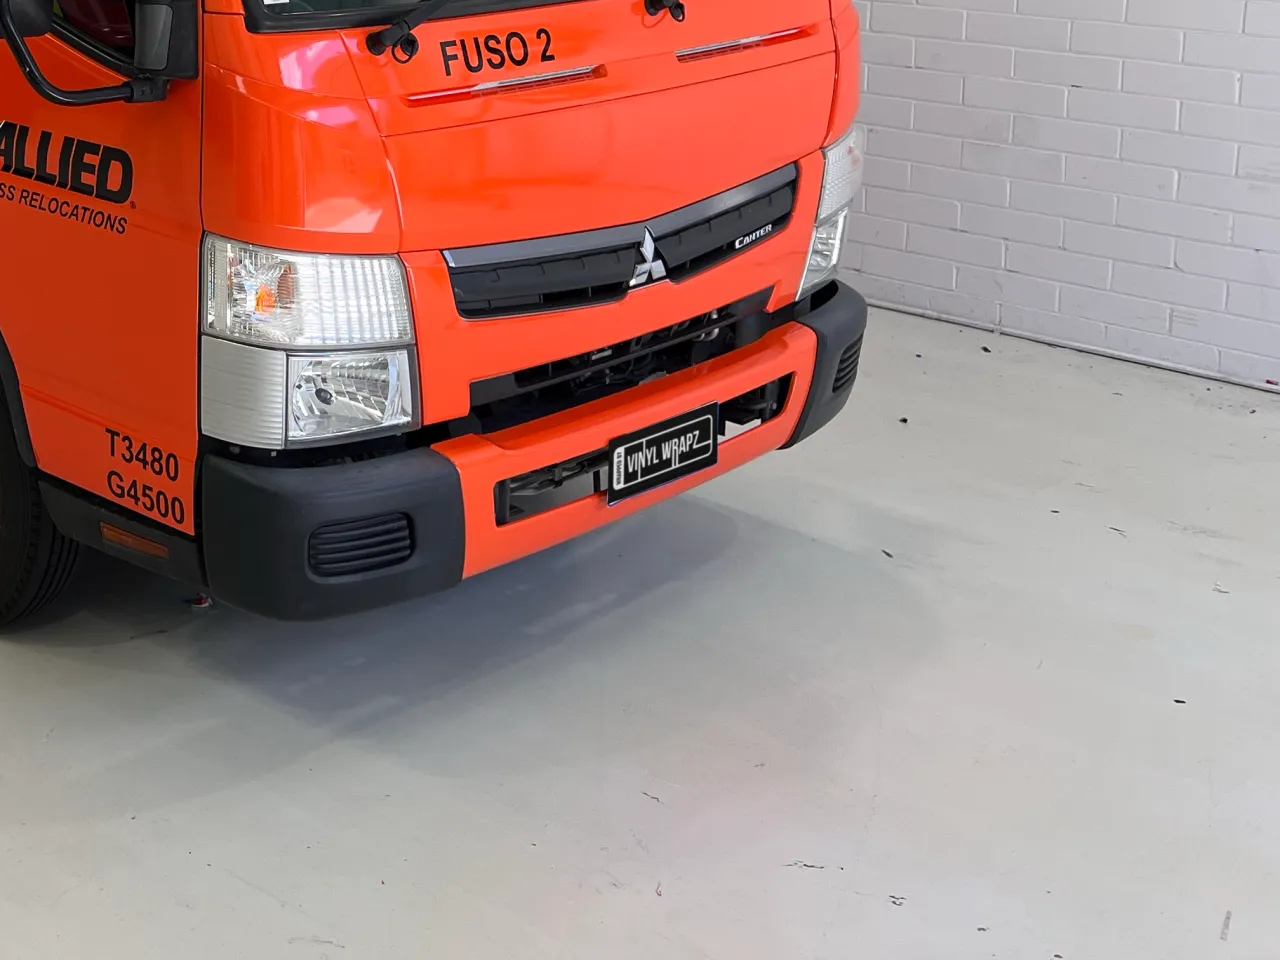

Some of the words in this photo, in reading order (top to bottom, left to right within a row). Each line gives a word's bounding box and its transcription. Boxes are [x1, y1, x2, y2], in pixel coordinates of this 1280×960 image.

[439, 31, 529, 77] FUSO
[536, 28, 555, 62] 2
[19, 189, 128, 235] RELOCATIONS
[734, 224, 773, 249] CANTER
[105, 426, 179, 482] T3480
[627, 443, 659, 475] VINYL
[662, 430, 700, 465] WRAPZ
[106, 470, 185, 525] G4500
